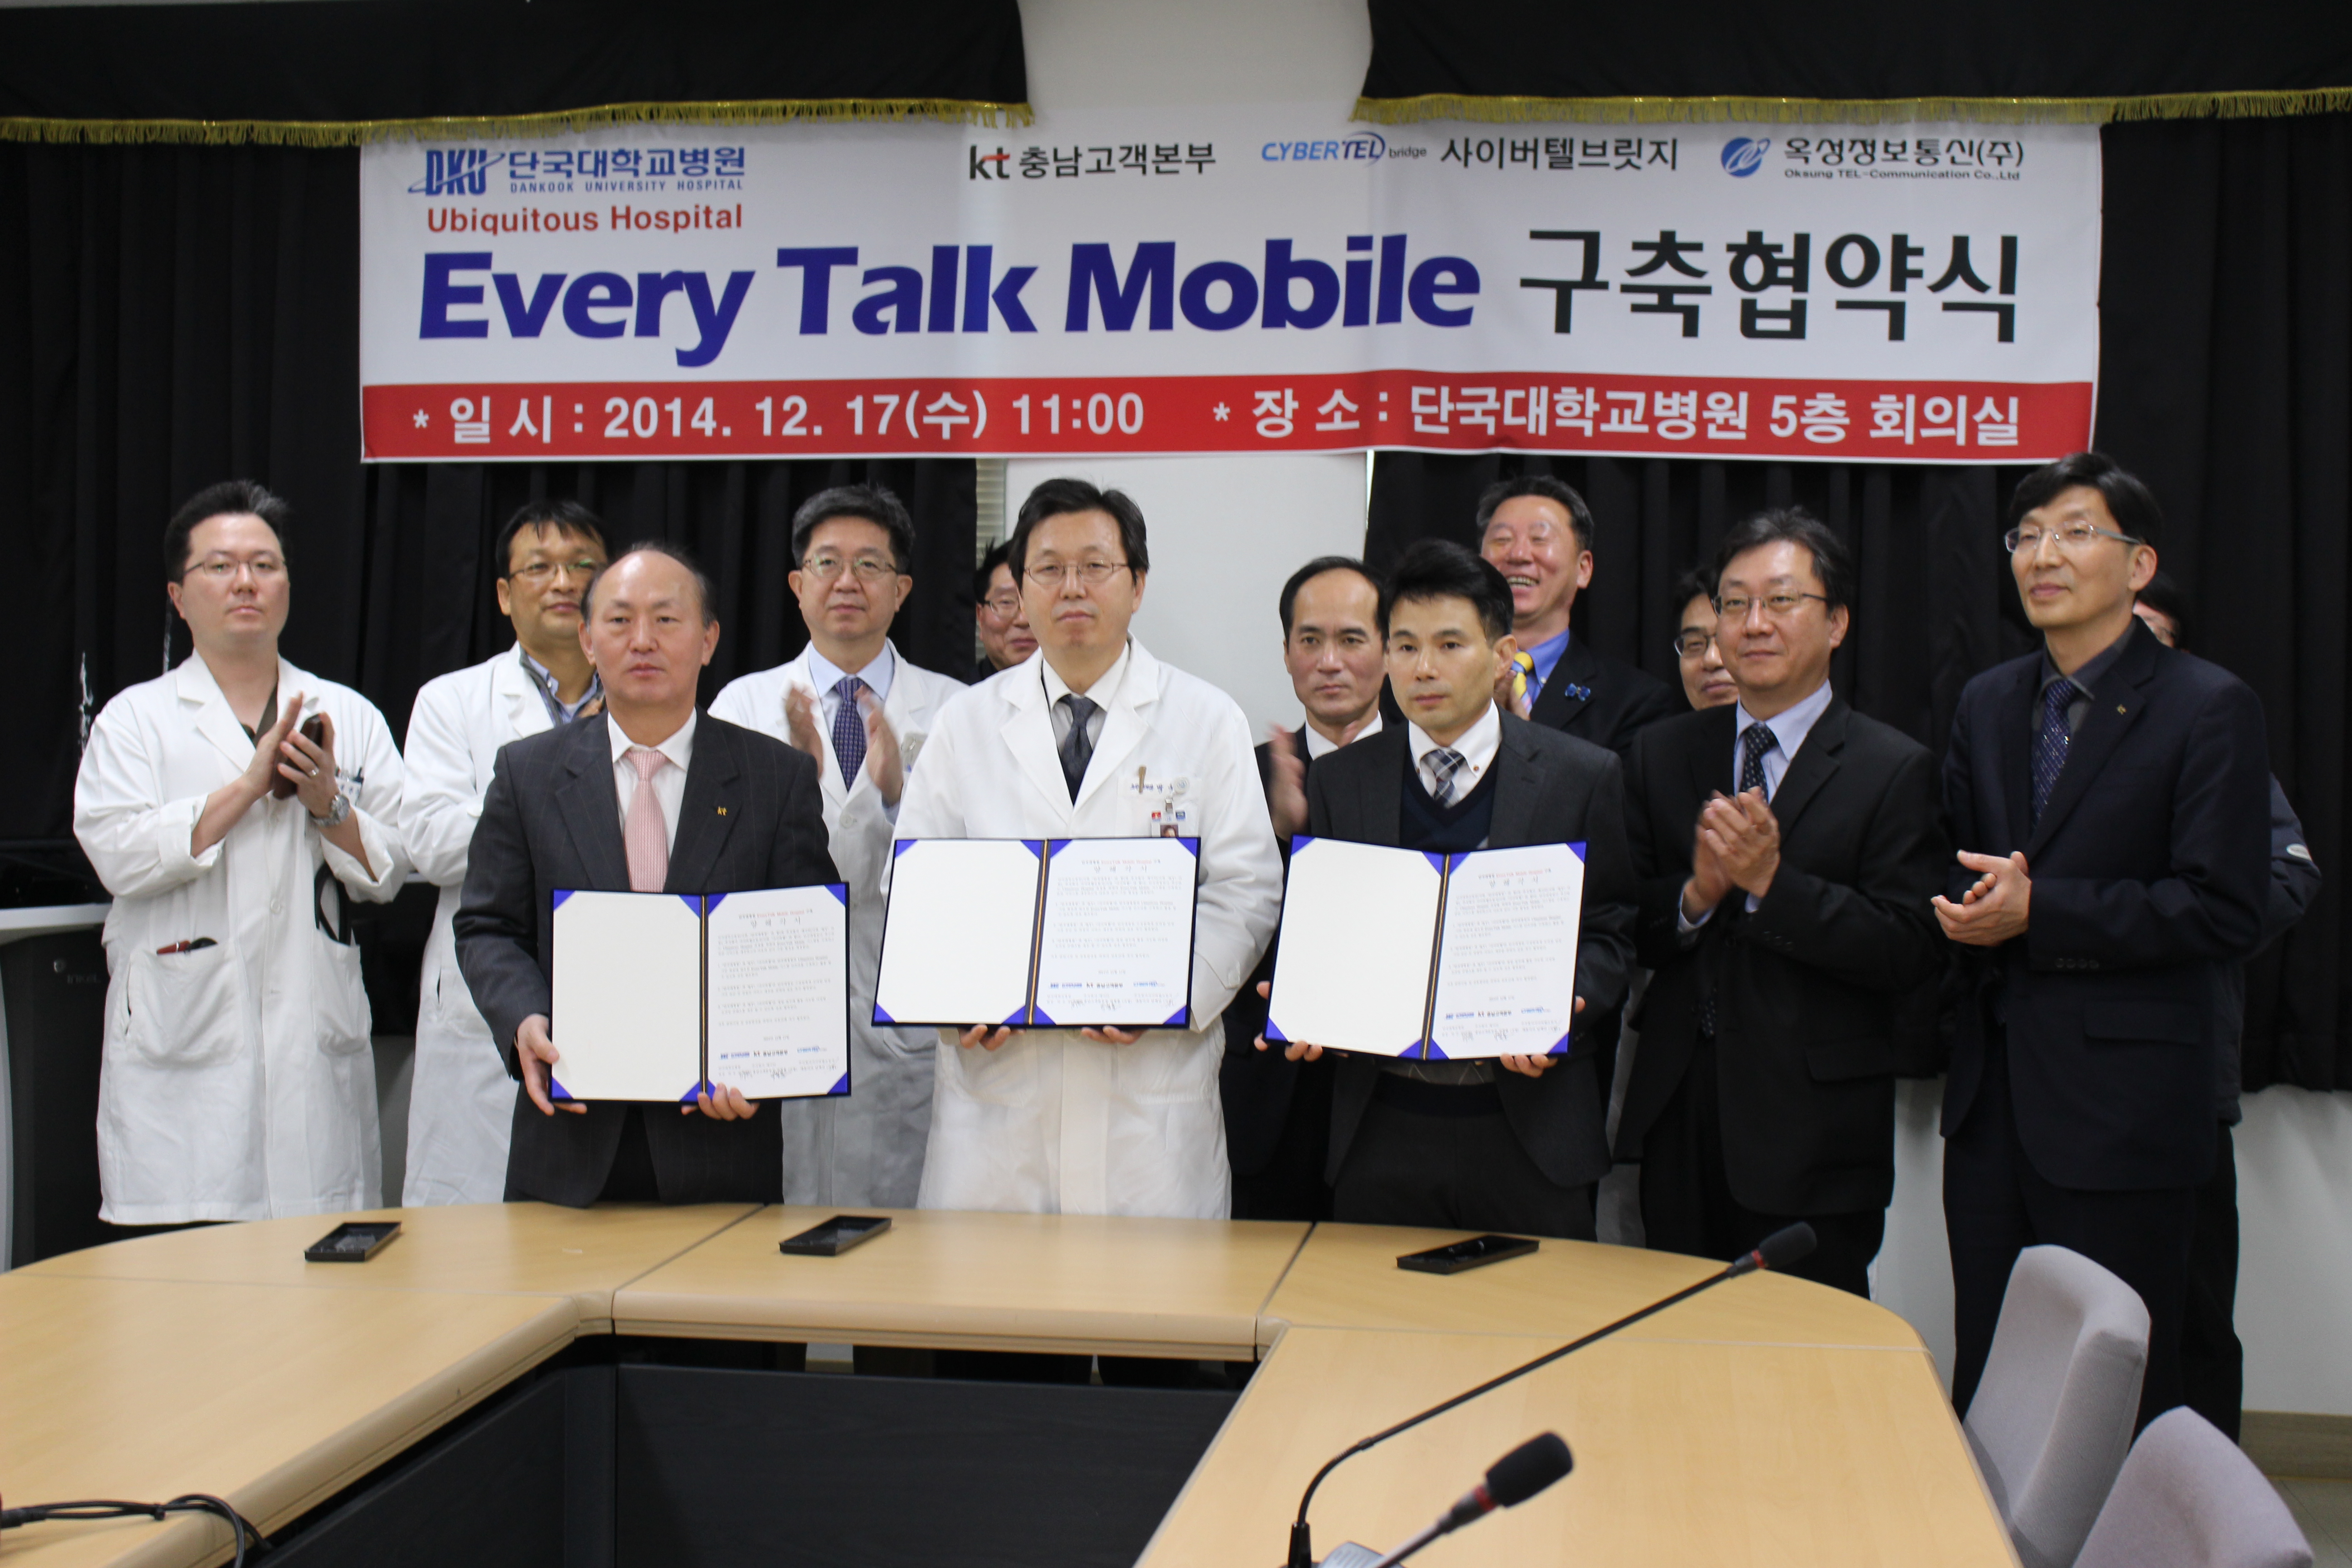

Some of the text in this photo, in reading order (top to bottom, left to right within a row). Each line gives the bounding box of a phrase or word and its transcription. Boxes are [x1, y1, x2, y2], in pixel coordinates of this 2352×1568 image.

[969, 142, 1216, 180] kt 충남고객본부
[1389, 146, 1427, 159] bridge
[1440, 136, 1678, 171] 사이버텔브릿지
[1784, 137, 2024, 167] 옥성정보통신(주)
[425, 147, 745, 196] DKU 단국대학교병원
[510, 180, 743, 193] DANKOOK UNIVERSITY HOSPITAL
[1784, 168, 1833, 180] Oksung
[428, 204, 742, 236] Ubiquitous Hospital
[419, 229, 2019, 368] Every Talk Mobile 구축협약식
[603, 397, 731, 438] 2014.
[755, 395, 822, 436] 12.
[846, 390, 987, 440] 17(수)
[1012, 392, 1144, 435] 11:00
[1411, 386, 1748, 441] 단국대학교병원
[1769, 392, 1851, 444] 5층
[1869, 394, 2019, 447] 회의실
